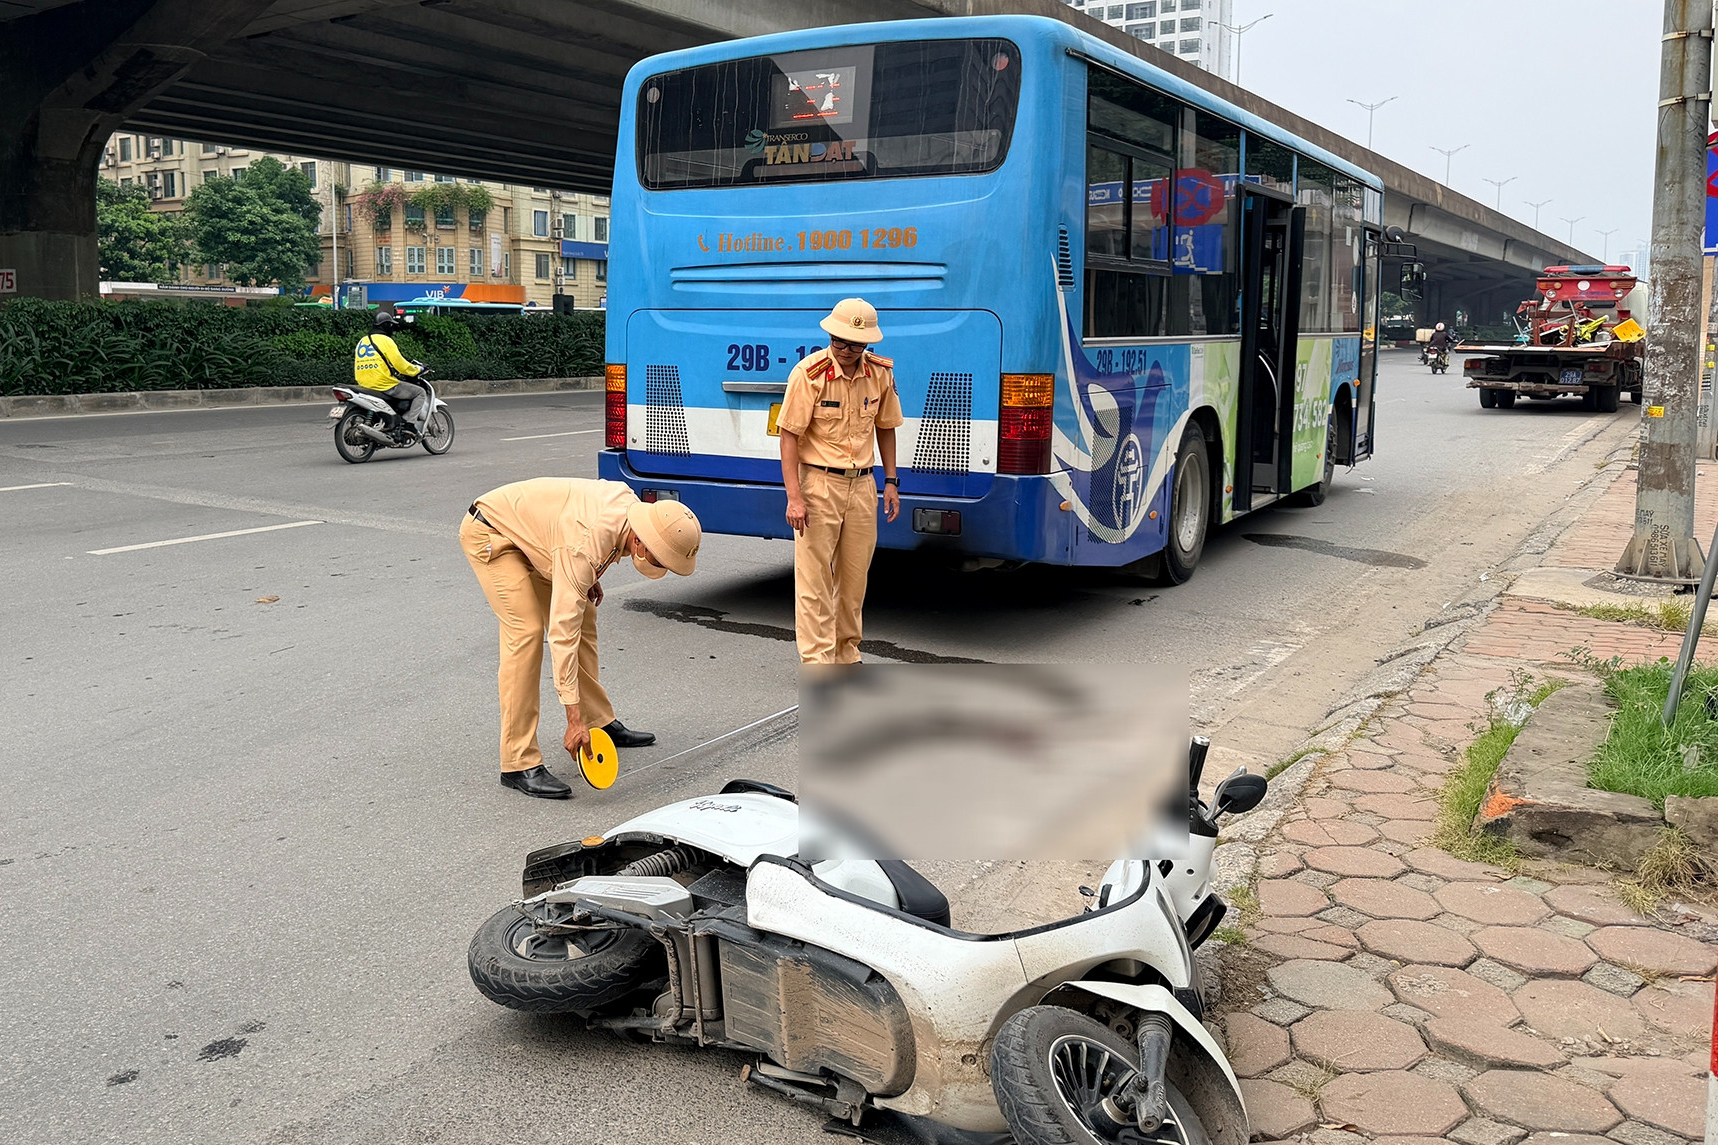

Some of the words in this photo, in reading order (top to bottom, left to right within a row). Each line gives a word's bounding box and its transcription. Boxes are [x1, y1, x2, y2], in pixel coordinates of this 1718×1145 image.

[767, 132, 809, 142] TRANSERCO
[797, 229, 852, 251] 1900
[859, 227, 918, 249] 1296
[425, 290, 445, 299] VIB
[357, 341, 375, 358] be
[726, 344, 769, 372] 29B
[1096, 349, 1113, 376] 29B
